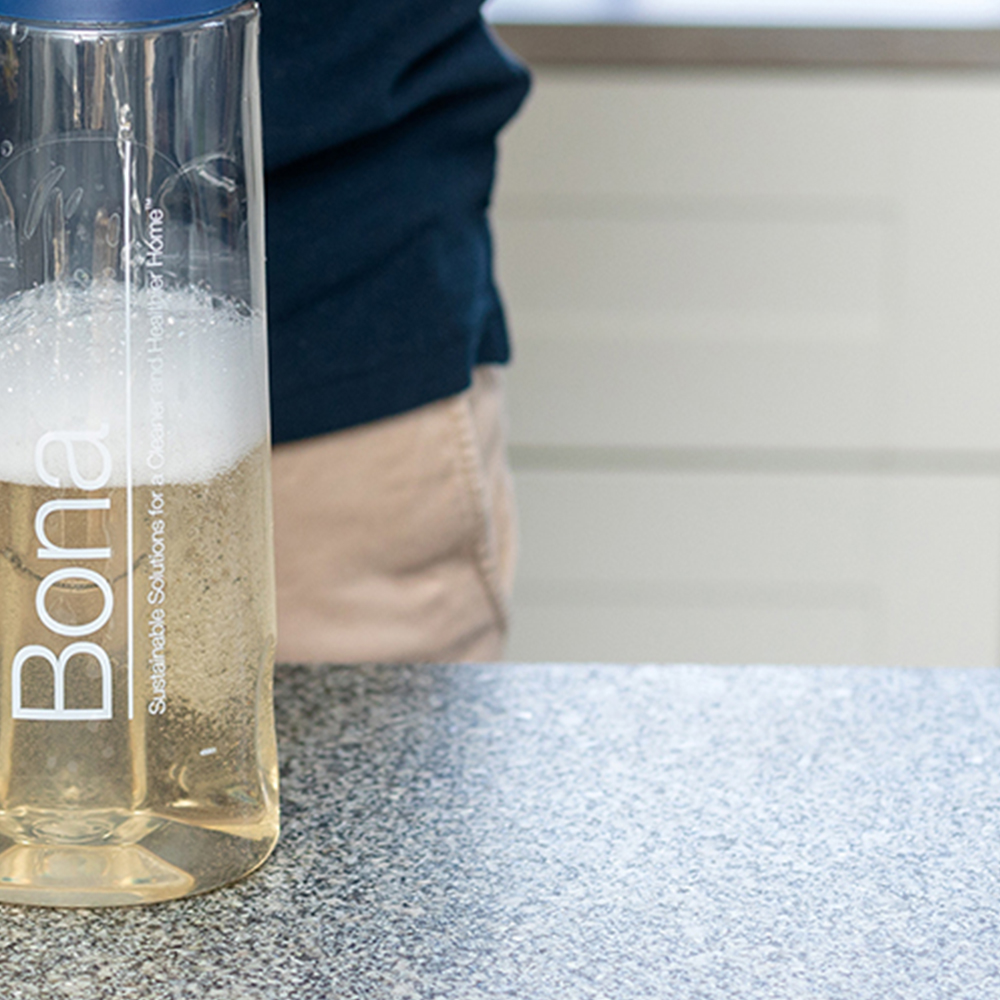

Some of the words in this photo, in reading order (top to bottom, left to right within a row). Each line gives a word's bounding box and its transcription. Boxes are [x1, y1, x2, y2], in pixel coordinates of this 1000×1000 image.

[148, 490, 165, 515] for
[154, 476, 164, 486] a
[11, 422, 114, 720] Bona
[147, 519, 165, 604] Solutions
[148, 608, 166, 715] Sustainable
